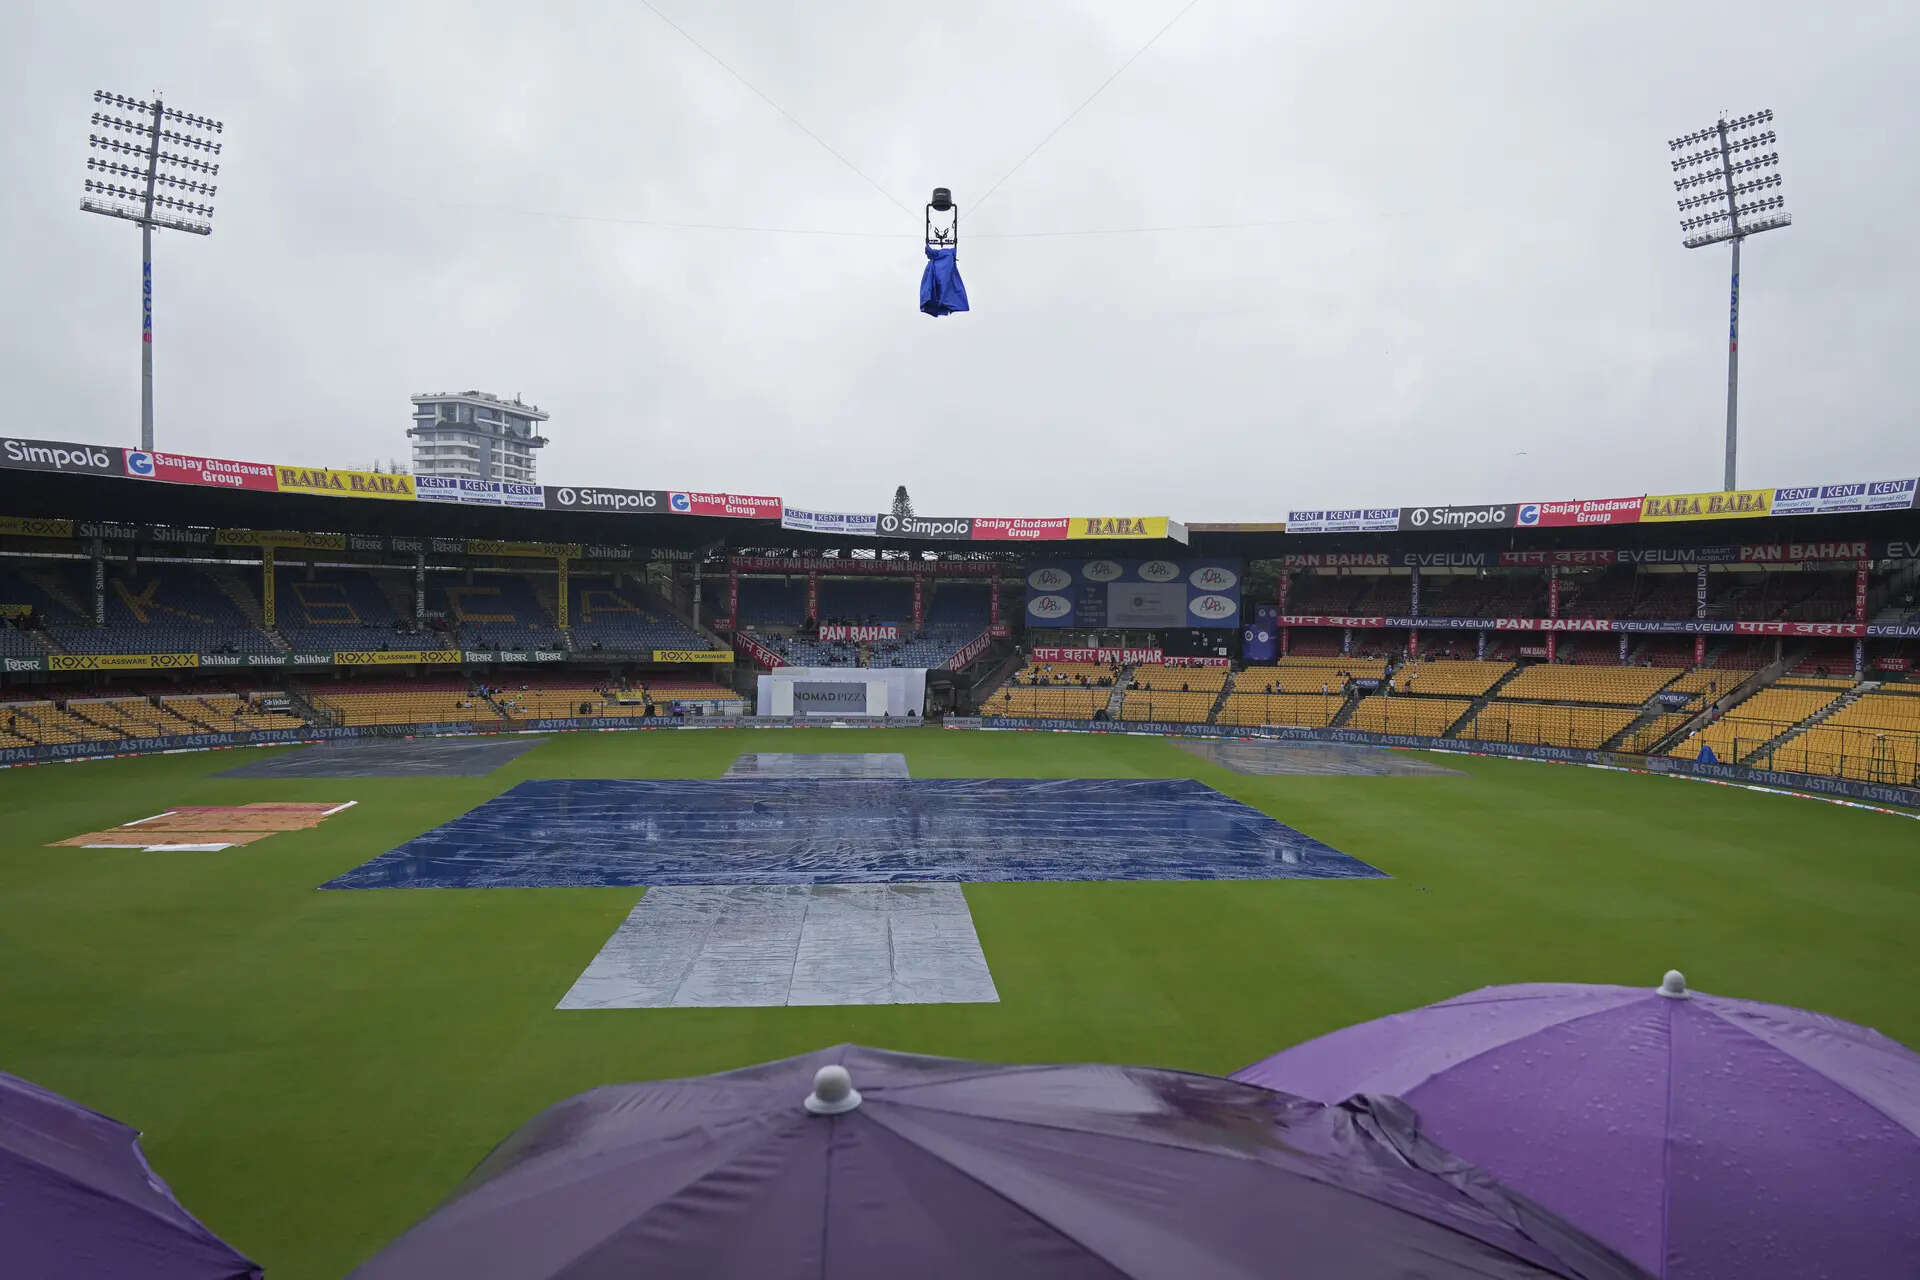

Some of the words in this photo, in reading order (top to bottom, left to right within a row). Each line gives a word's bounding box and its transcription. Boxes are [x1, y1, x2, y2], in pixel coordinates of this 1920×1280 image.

[4, 440, 110, 469] Simpolo
[155, 453, 202, 471] Sanjay
[206, 459, 273, 477] Ghodawat
[202, 471, 243, 485] Group
[279, 469, 346, 491] BABA
[348, 474, 413, 495] BABA
[422, 478, 451, 488] KENT
[465, 481, 494, 492] KENT
[508, 484, 537, 495] KENT
[1826, 485, 1859, 497] KENT
[1874, 480, 1908, 494] KENT
[581, 490, 656, 509] Simpolo
[1781, 488, 1812, 500] KENT
[691, 494, 726, 506] Sanjay
[728, 495, 779, 507] Ghodawat
[1645, 500, 1702, 517] BABA
[1707, 494, 1766, 513] BABA
[725, 504, 756, 515] Group
[1542, 502, 1577, 515] Sanjay
[1579, 499, 1642, 513] Ghodawat
[788, 510, 808, 519] KENT
[818, 514, 840, 522] KENT
[850, 515, 871, 523] KENT
[1294, 512, 1319, 521] KENT
[1330, 511, 1355, 520] KENT
[1368, 510, 1393, 519] KENT
[1432, 508, 1505, 528] Simpolo
[1577, 511, 1611, 524] Group
[23, 520, 69, 535] ROXX
[902, 515, 969, 536] Simpolo
[975, 518, 1011, 529] Sanjay
[1013, 518, 1067, 528] Ghodawat
[1085, 518, 1147, 536] BABA
[79, 522, 138, 538] Shikhar
[152, 527, 210, 544] Shikhar
[218, 532, 259, 545] ROXX
[1008, 528, 1040, 538] Group
[304, 535, 341, 548] ROXX
[469, 543, 504, 554] ROXX
[588, 547, 633, 559] Shikhar
[651, 549, 694, 560] Shikhar
[1740, 546, 1781, 560] PAN
[1789, 543, 1866, 559] BAHAR
[1286, 553, 1320, 566] PAN
[1326, 553, 1389, 566] BAHAR
[1404, 553, 1484, 566] EVEIUM
[1503, 551, 1547, 564] पान
[1554, 550, 1613, 563] बहार
[1617, 549, 1695, 562] EVEIUM
[804, 558, 836, 569] BAHAR
[1697, 565, 1707, 618] EVEIUM
[1283, 616, 1322, 626] पान
[1385, 618, 1428, 627] EVEIUM
[1451, 619, 1494, 628] EVEIUM
[1496, 619, 1533, 630] PAN
[1541, 619, 1609, 631] BAHAR
[1611, 622, 1659, 631] EVEIUM
[1738, 622, 1788, 632] पान
[819, 626, 846, 640] PAN
[850, 626, 897, 640] BAHAR
[1685, 623, 1733, 632] EVEIUM
[337, 652, 376, 663] ROXX
[421, 651, 458, 662] ROXX
[660, 651, 694, 662] ROXX
[949, 649, 968, 671] PAN
[967, 633, 992, 660] BAHAR
[1035, 648, 1059, 660] पान
[1063, 649, 1096, 662] बहार
[1098, 650, 1120, 662] PAN
[1123, 650, 1163, 663] BAHAR
[52, 657, 99, 669] ROXX
[151, 655, 195, 667] ROXX
[202, 656, 240, 666] Shikhar
[248, 655, 286, 665] Shikhar
[293, 654, 331, 664] Shikhar
[538, 719, 579, 728] ASTRAL
[591, 718, 631, 727] ASTRAL
[643, 717, 683, 726] ASTRAL
[993, 719, 1030, 727] ASTRAL
[1040, 720, 1077, 729] ASTRAL
[1088, 721, 1125, 730] ASTRAL
[1136, 722, 1174, 732] ASTRAL
[249, 731, 296, 741] ASTRAL
[311, 727, 358, 738] ASTRAL
[1184, 725, 1220, 735] ASTRAL
[1280, 730, 1320, 740] ASTRAL
[186, 734, 234, 745] ASTRAL
[1331, 732, 1369, 742] ASTRAL
[1380, 735, 1419, 746] ASTRAL
[51, 743, 103, 756] ASTRAL
[120, 738, 170, 750] ASTRAL
[1431, 739, 1471, 750] ASTRAL
[1482, 742, 1520, 754] ASTRAL
[1532, 746, 1573, 759] ASTRAL
[1692, 764, 1735, 778] ASTRAL
[1747, 771, 1793, 785] ASTRAL
[1805, 779, 1849, 795] ASTRAL
[1862, 787, 1909, 804] ASTRAL
